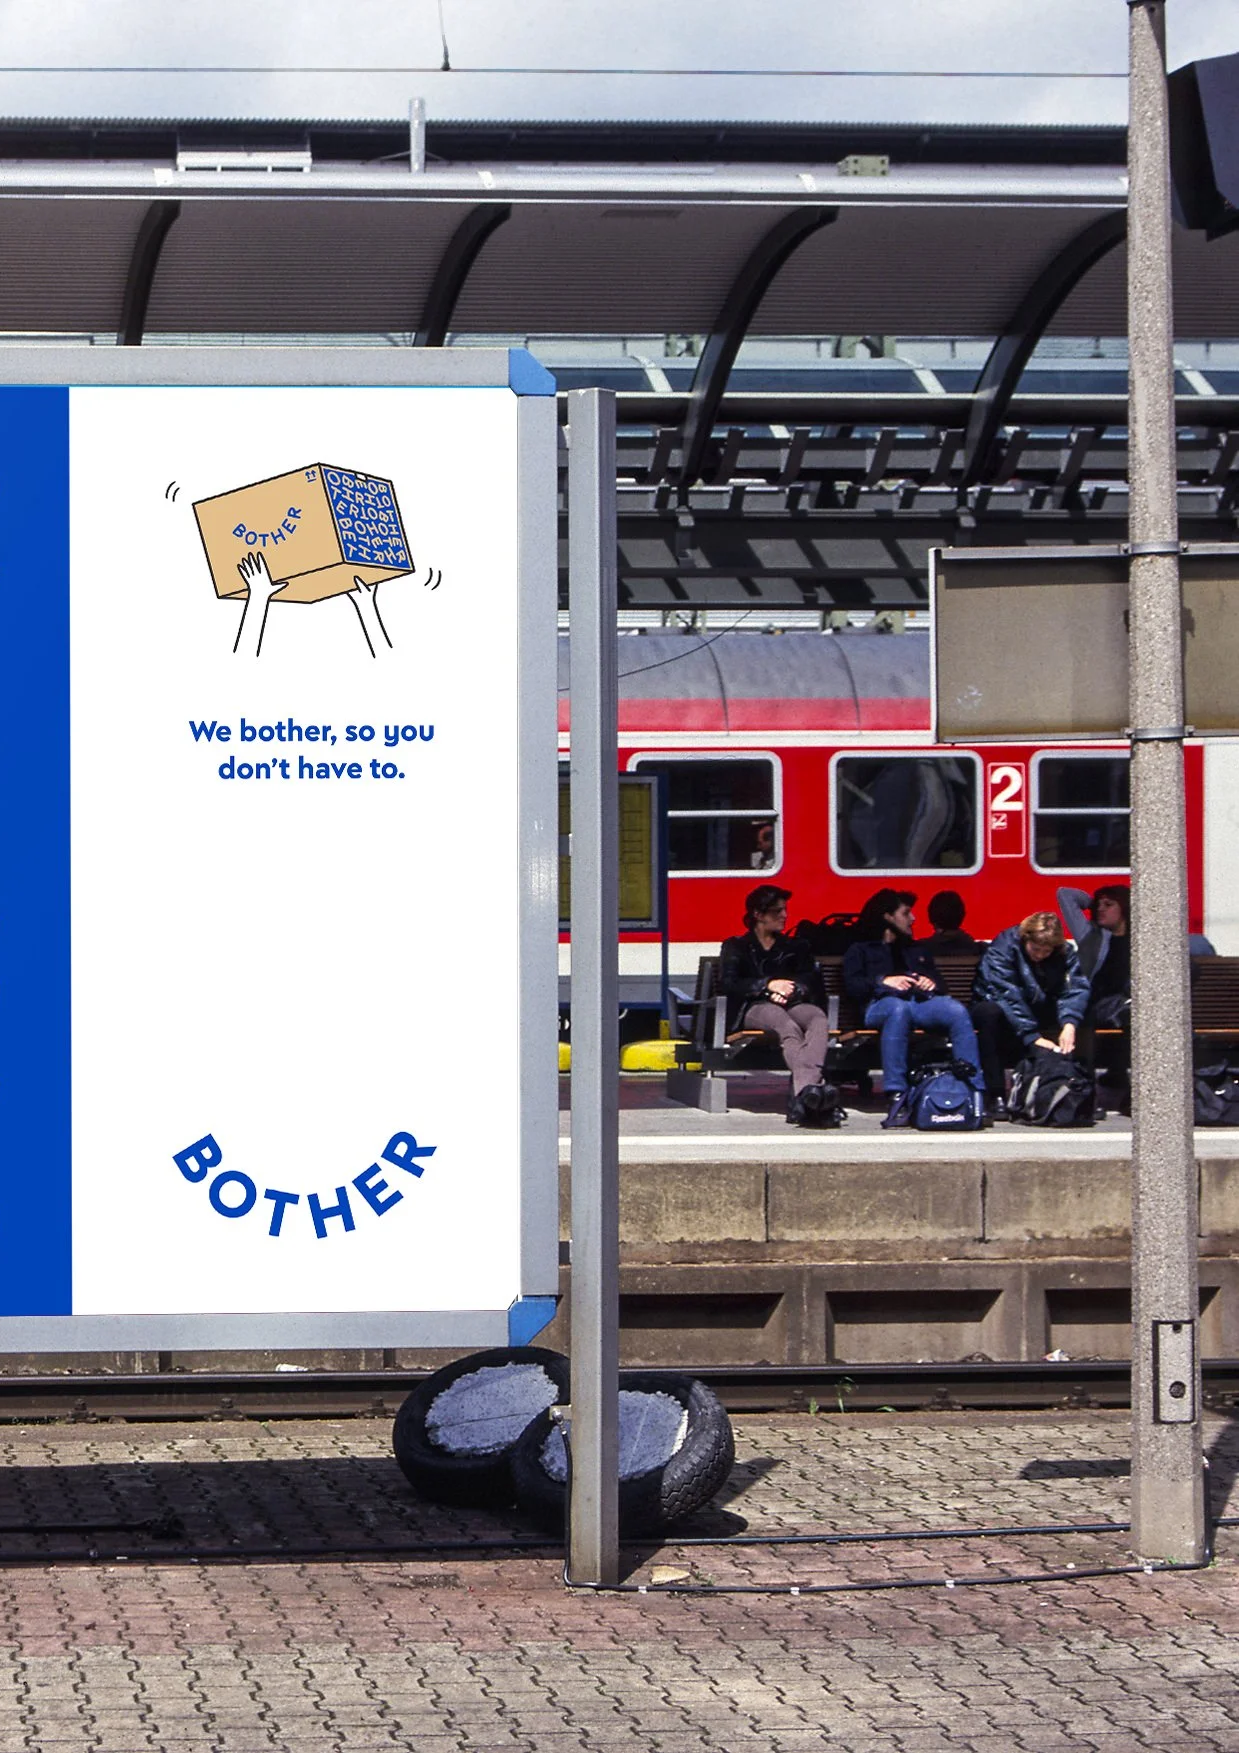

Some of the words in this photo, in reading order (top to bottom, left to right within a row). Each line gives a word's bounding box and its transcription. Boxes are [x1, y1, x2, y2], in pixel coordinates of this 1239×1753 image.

[232, 506, 302, 547] BOTHER
[189, 721, 231, 742] We
[241, 718, 337, 745] bother,
[346, 725, 375, 741] so
[384, 725, 434, 747] you
[219, 756, 290, 779] don’t
[299, 756, 362, 779] have
[370, 759, 405, 778] to.
[991, 766, 1023, 811] 2
[173, 1132, 437, 1239] BOTHER
